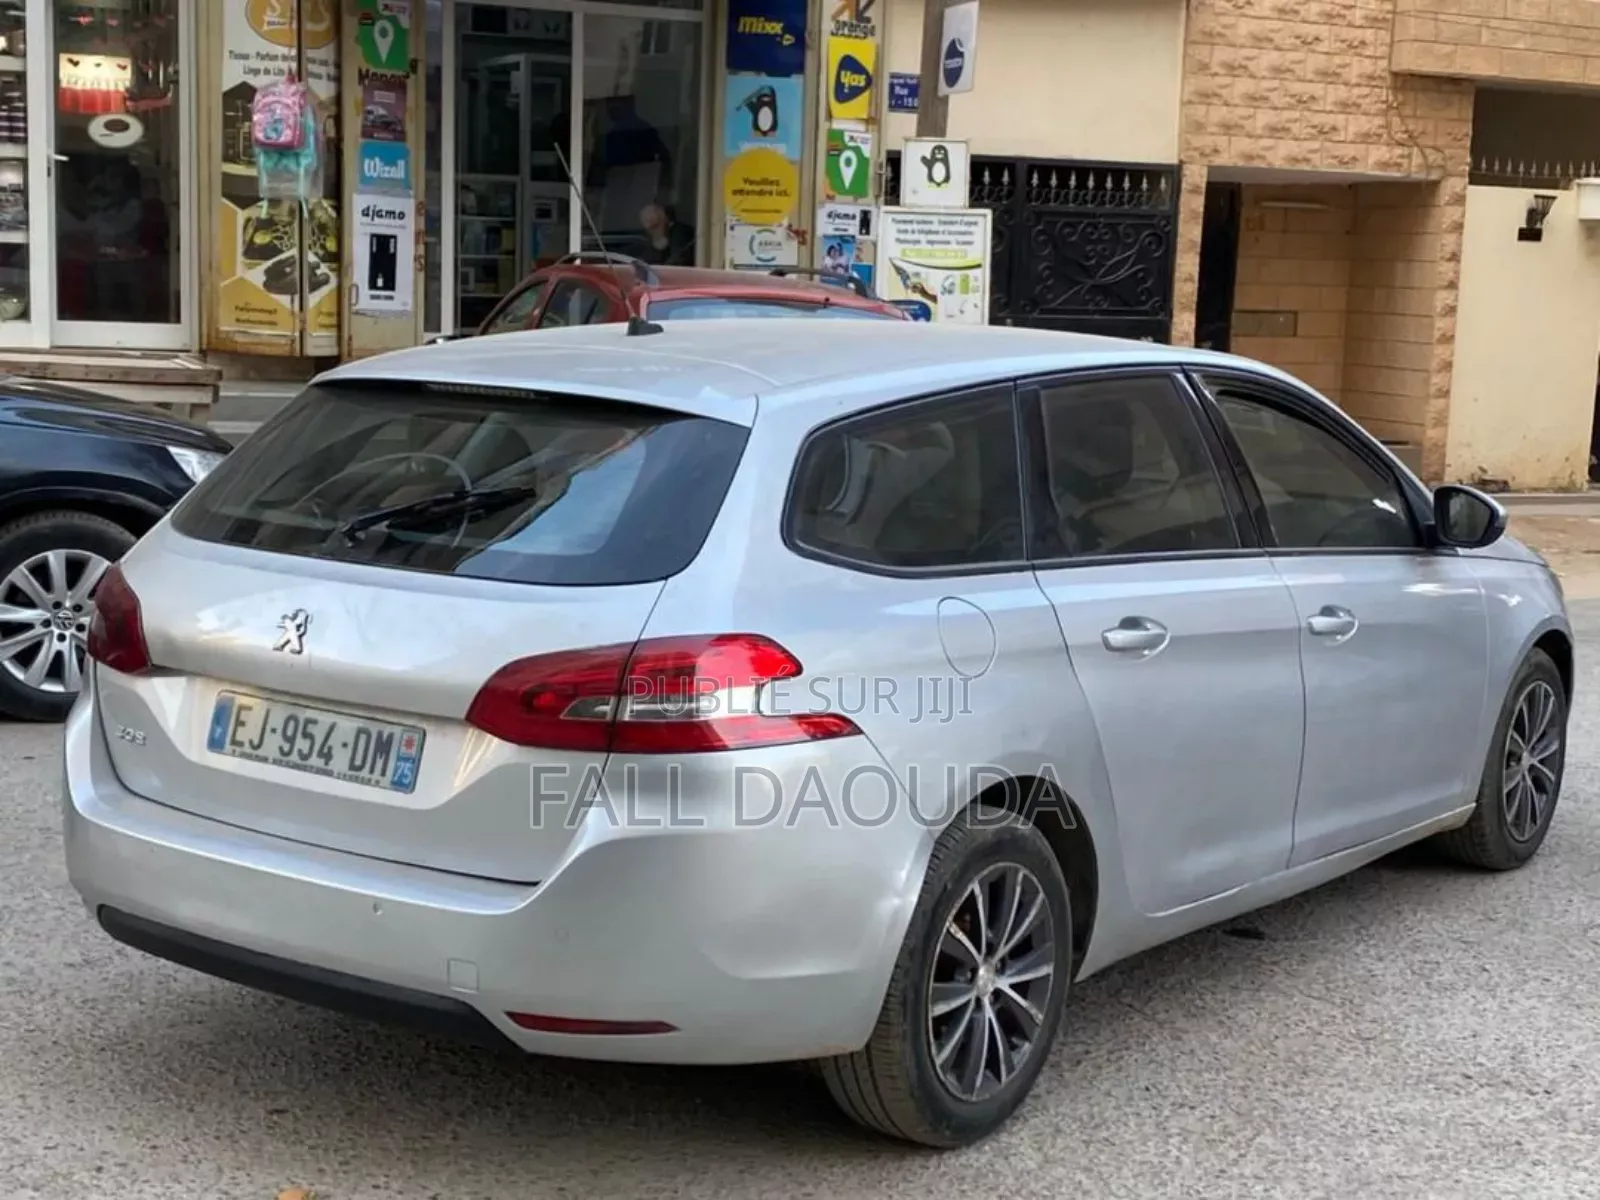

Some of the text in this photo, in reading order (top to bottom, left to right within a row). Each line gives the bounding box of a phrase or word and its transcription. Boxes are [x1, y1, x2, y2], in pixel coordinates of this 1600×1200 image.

[361, 204, 406, 222] djamo
[229, 703, 396, 778] EJ-954-DM
[395, 760, 413, 784] 75
